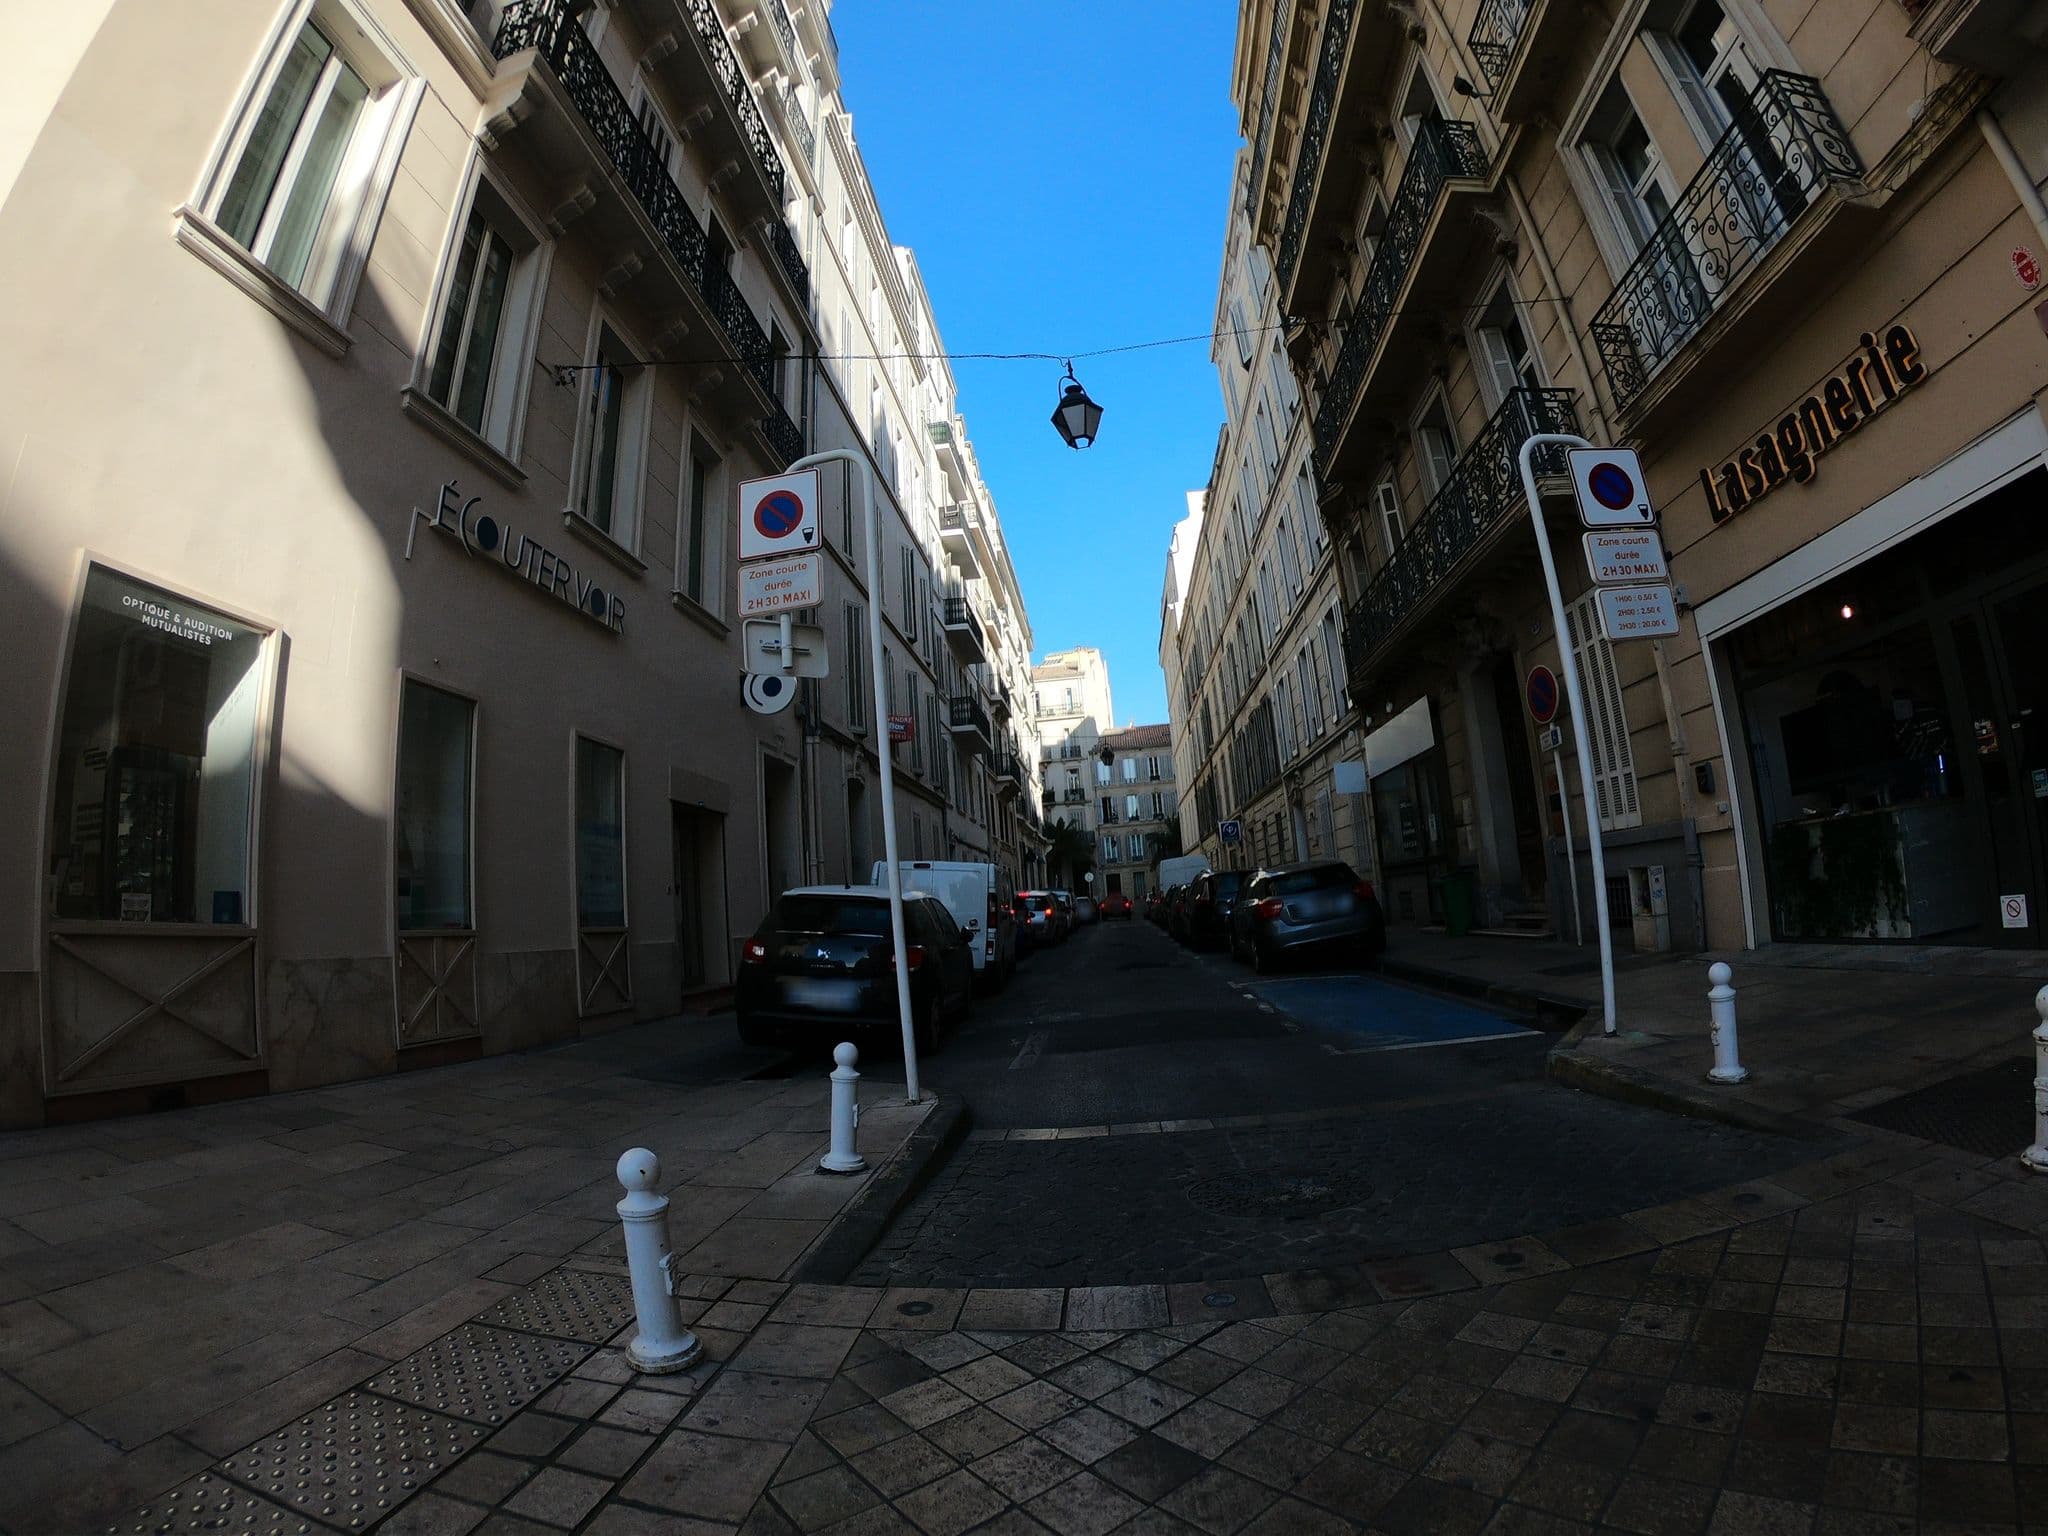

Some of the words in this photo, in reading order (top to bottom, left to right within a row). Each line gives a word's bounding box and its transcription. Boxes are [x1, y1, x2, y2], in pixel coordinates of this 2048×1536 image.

[1700, 325, 1928, 523] Lasagnerie
[1597, 537, 1620, 547] Zone
[1622, 536, 1650, 545] courte
[436, 479, 571, 600] ÉCOUTER
[575, 570, 625, 634] VOIR
[1614, 551, 1640, 560] durée
[749, 569, 773, 580] Zone
[776, 564, 807, 574] courte
[1634, 564, 1659, 575] MAXI
[764, 580, 792, 591] durée
[783, 590, 810, 603] MAXI
[122, 595, 170, 620] OPTIQUE
[173, 613, 180, 623] &
[184, 616, 233, 641] AUDITION
[142, 614, 211, 645] MUTUALISTES
